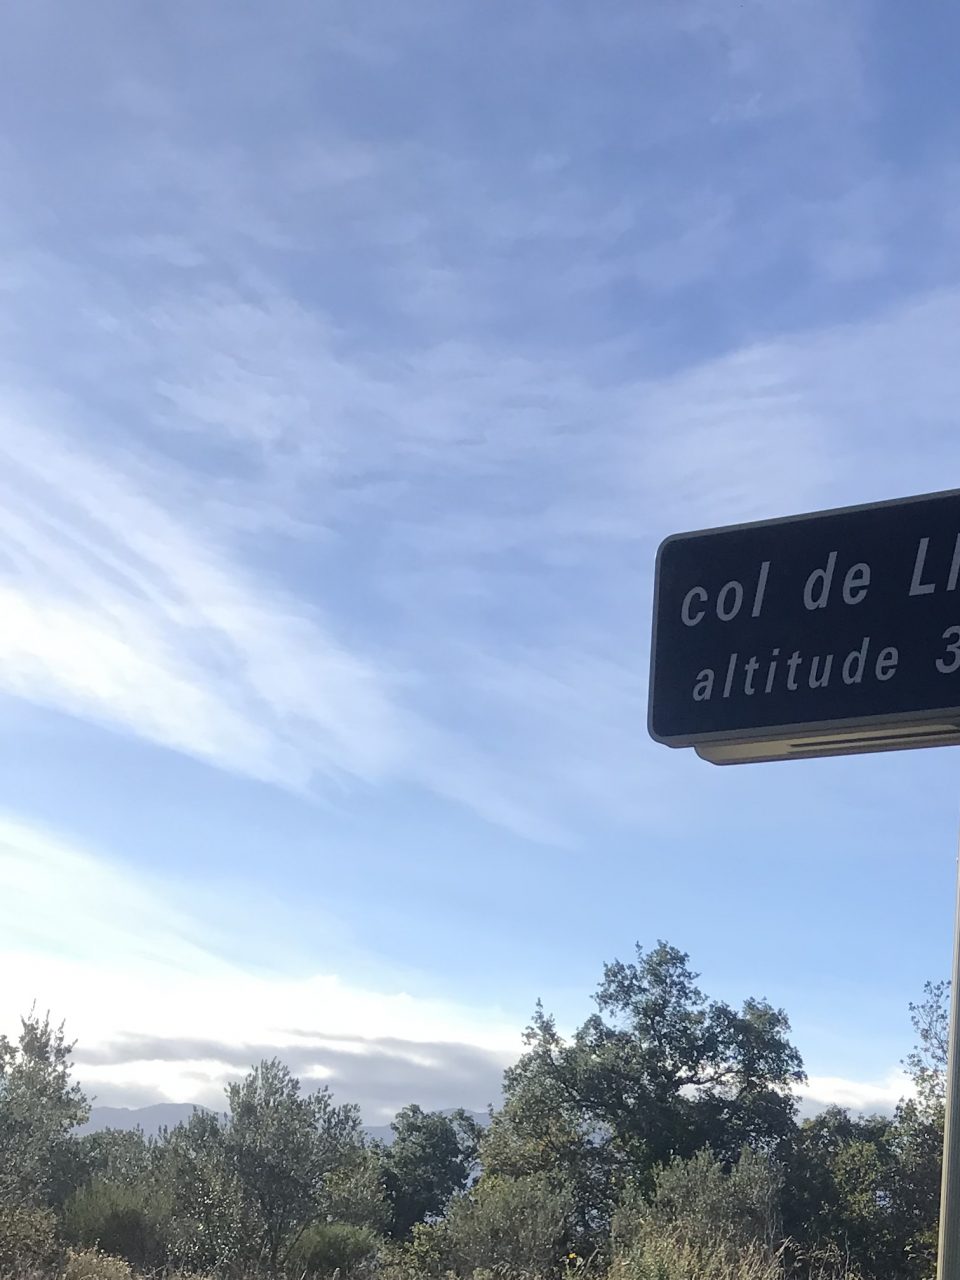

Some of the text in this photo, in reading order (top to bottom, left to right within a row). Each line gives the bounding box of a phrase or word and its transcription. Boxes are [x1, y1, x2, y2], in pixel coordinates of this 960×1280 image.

[681, 561, 770, 627] col
[803, 551, 871, 611] de
[692, 637, 899, 701] altitude
